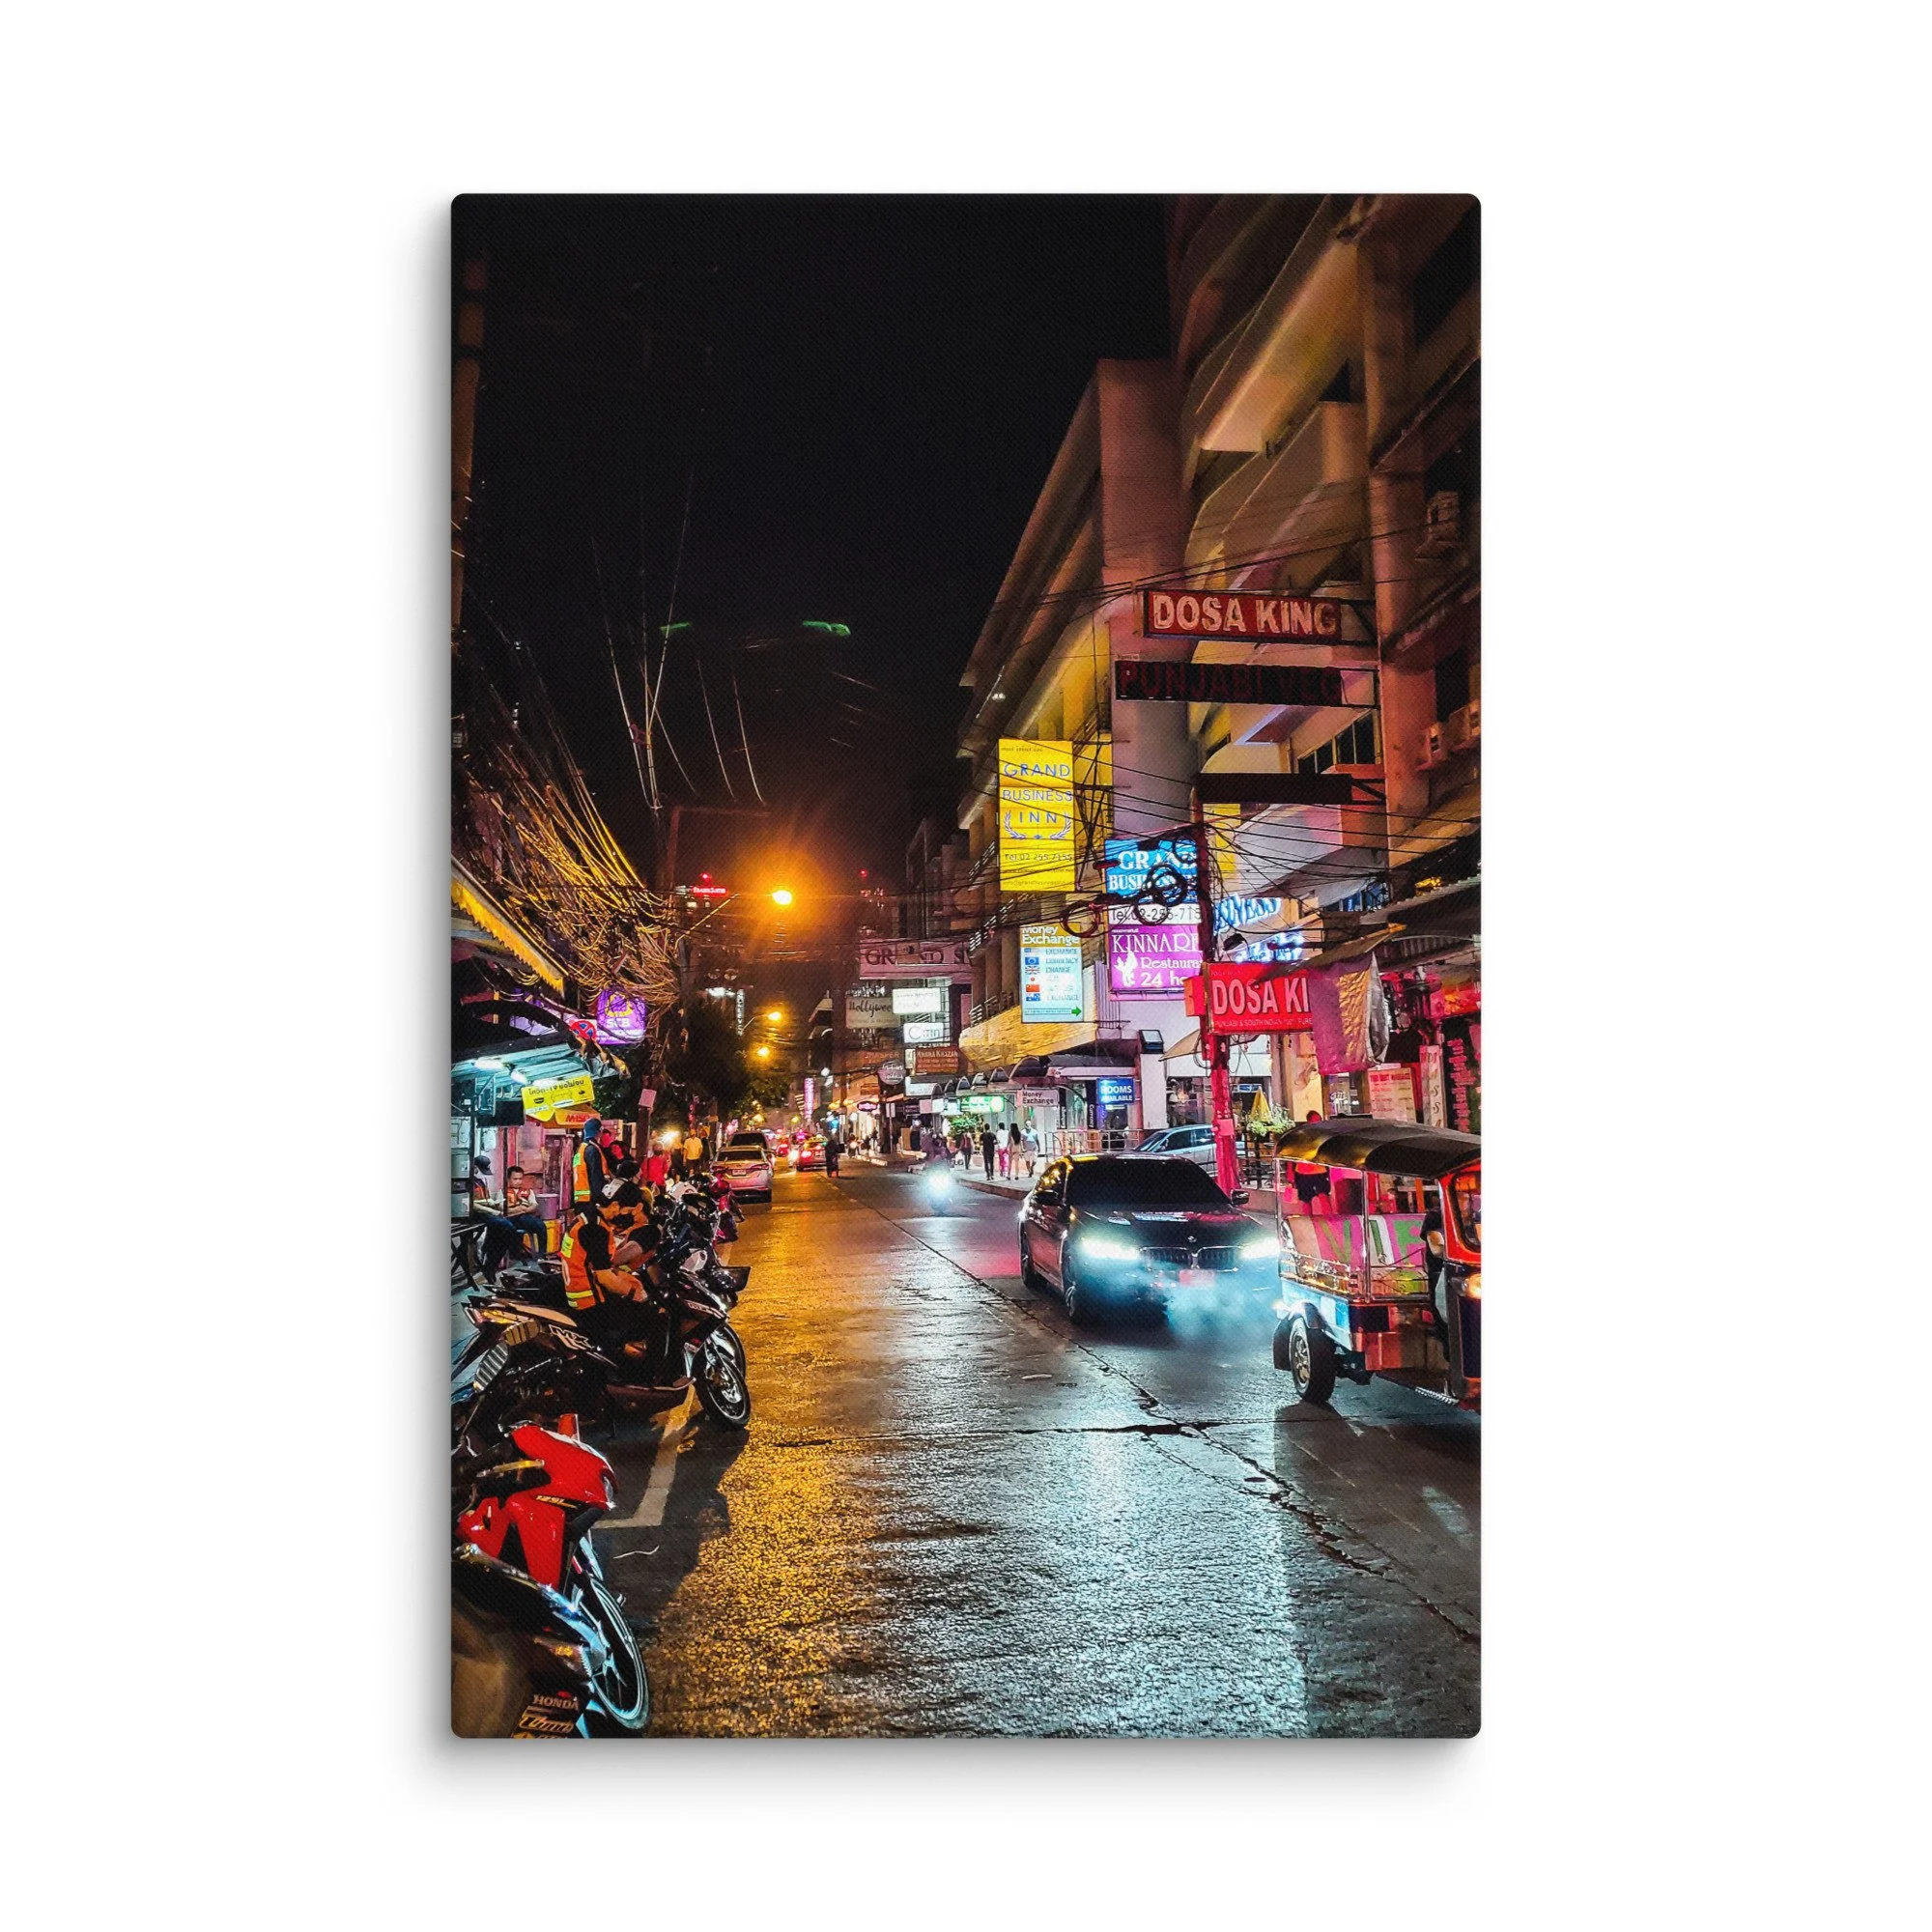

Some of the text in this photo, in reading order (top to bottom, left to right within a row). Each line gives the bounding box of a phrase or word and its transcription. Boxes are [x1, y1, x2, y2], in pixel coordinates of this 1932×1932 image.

[1152, 594, 1337, 636] DOSA KING
[1118, 662, 1264, 701] PUNJABI
[1003, 763, 1071, 778] GRAND
[1002, 789, 1073, 802] BUSINESS
[1018, 811, 1058, 824] INN
[1022, 925, 1059, 935] Money
[1022, 934, 1079, 946] Exchange
[1140, 972, 1163, 987] 24
[1211, 979, 1279, 1015] DOSA
[1100, 1085, 1133, 1094] ROOMS
[1022, 1097, 1054, 1106] Exchange
[532, 1694, 580, 1711] HONDA
